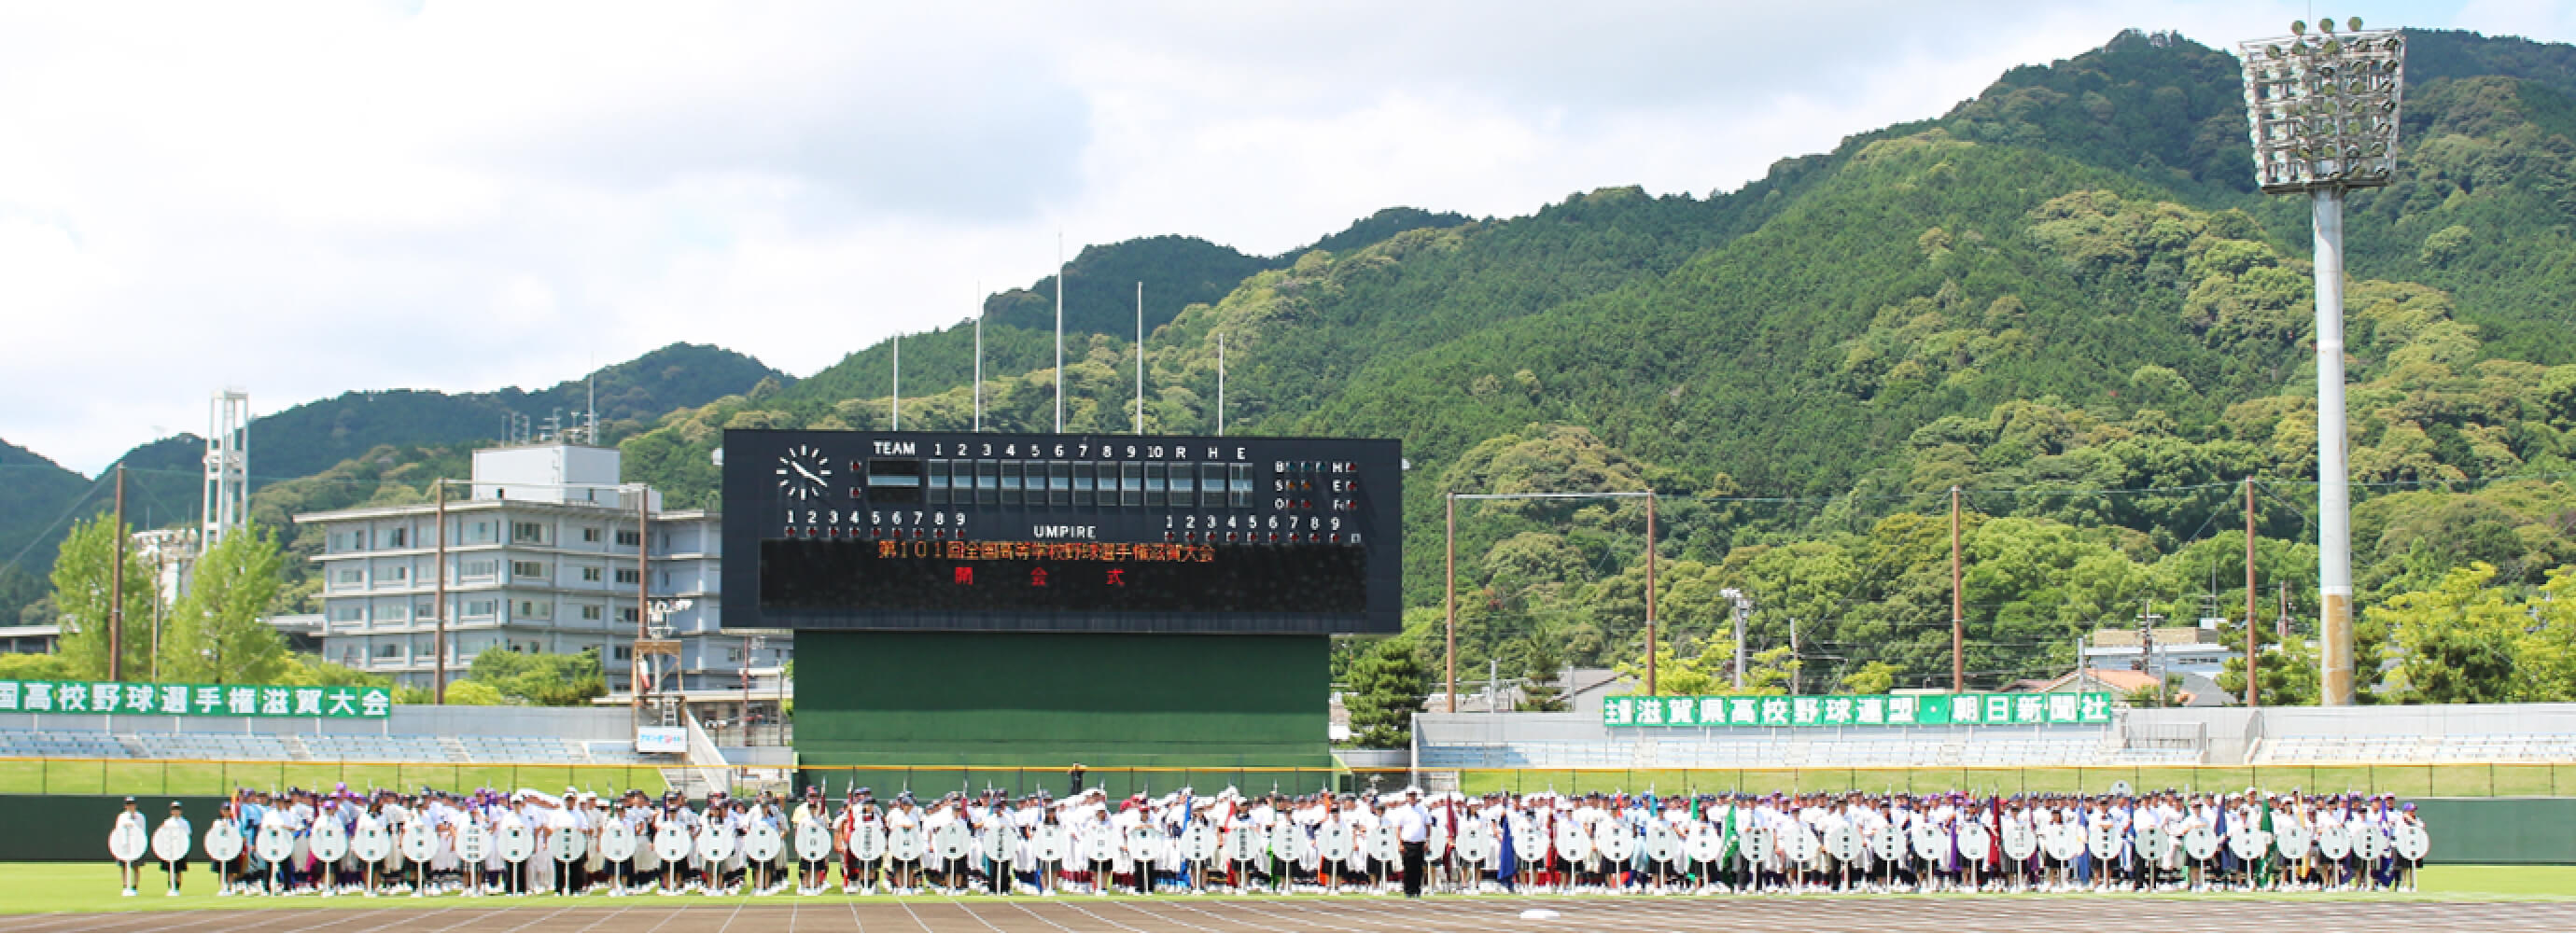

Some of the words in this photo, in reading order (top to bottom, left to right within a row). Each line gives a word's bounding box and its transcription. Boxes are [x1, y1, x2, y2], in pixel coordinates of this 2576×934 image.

[873, 440, 916, 455] TEAM
[934, 443, 942, 456] 1
[958, 443, 968, 456] 2
[982, 443, 992, 456] 3
[1006, 443, 1016, 456] 4
[1030, 444, 1041, 457] 5
[1055, 444, 1065, 457] 6
[1079, 444, 1089, 457] 7
[1102, 445, 1113, 458] 8
[1127, 445, 1137, 458] 9
[1147, 445, 1164, 458] 10
[1175, 446, 1186, 459] R
[1208, 447, 1218, 459] H
[1237, 447, 1246, 459] E
[1332, 462, 1342, 473] H
[1275, 480, 1283, 492] S
[1332, 480, 1342, 493] E
[788, 510, 794, 523] 1
[807, 510, 818, 523] 2
[829, 510, 839, 523] 3
[849, 510, 860, 523] 4
[872, 510, 880, 524] 5
[892, 511, 902, 524] 6
[914, 511, 923, 524] 7
[934, 511, 945, 524] 8
[956, 512, 966, 525] 9
[1166, 515, 1173, 529] 1
[1186, 515, 1196, 529] 2
[1207, 515, 1216, 529] 3
[1227, 515, 1237, 529] 4
[1248, 515, 1257, 529] 5
[1268, 516, 1278, 530] 6
[1290, 516, 1299, 530] 7
[1309, 516, 1320, 530] 8
[1330, 516, 1340, 530] 9
[1033, 525, 1097, 539] UMPIRE
